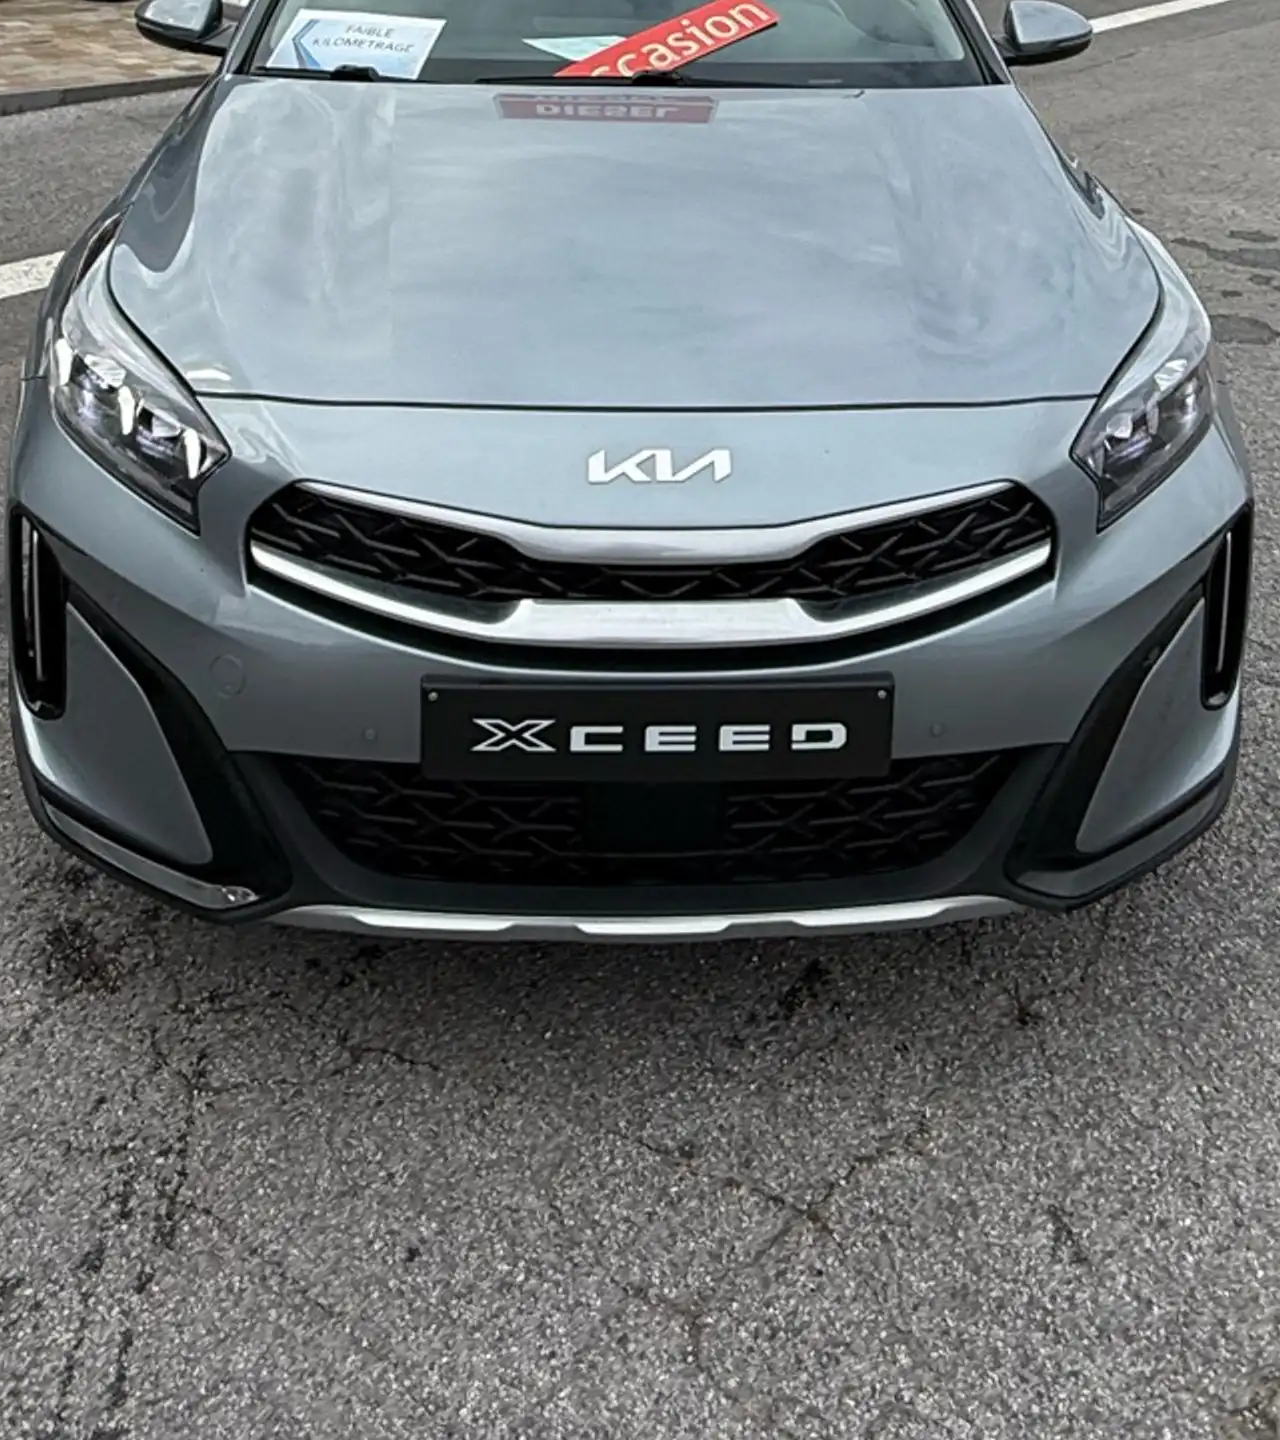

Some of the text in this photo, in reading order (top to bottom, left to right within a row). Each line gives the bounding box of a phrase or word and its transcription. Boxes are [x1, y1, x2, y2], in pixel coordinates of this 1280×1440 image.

[345, 24, 395, 38] FAIBLE
[588, 448, 732, 484] KIA
[470, 718, 847, 752] XCEED
